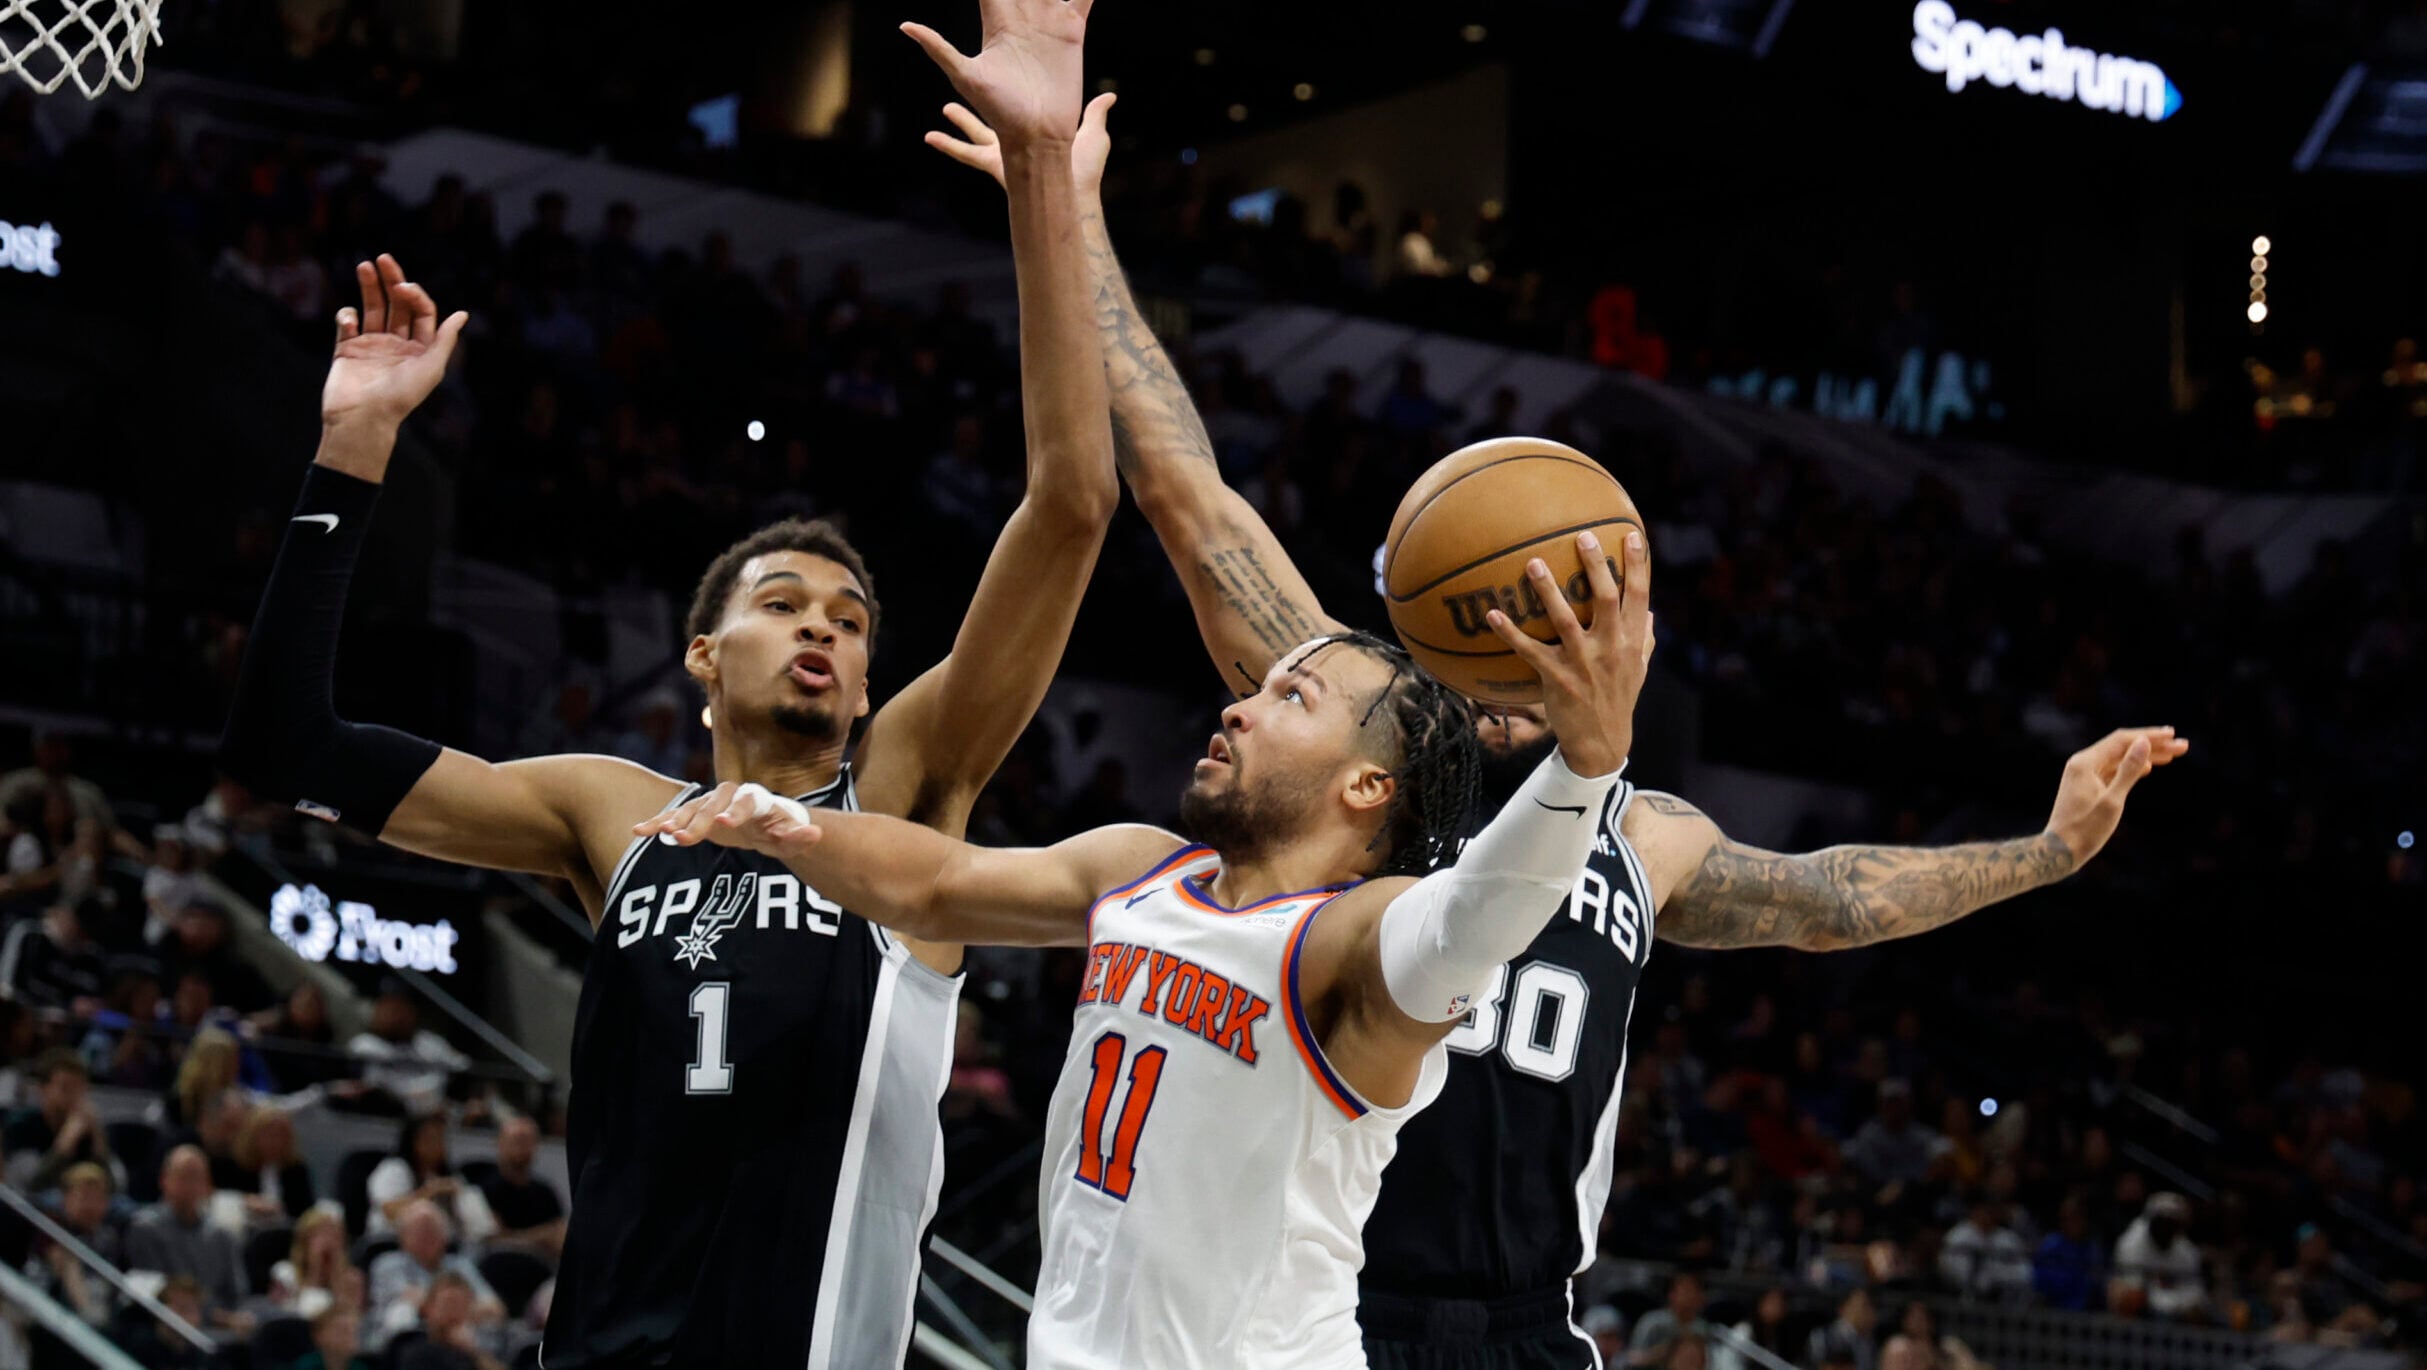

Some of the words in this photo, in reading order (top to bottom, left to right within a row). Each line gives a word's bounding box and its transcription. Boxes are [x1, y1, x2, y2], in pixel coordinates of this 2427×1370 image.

[1911, 0, 2166, 122] Spectrum
[335, 900, 459, 975] Frost
[618, 872, 843, 970] SPURS
[685, 981, 735, 1095] 1
[1138, 949, 1271, 1068] YORK
[1073, 1031, 1168, 1203] 11
